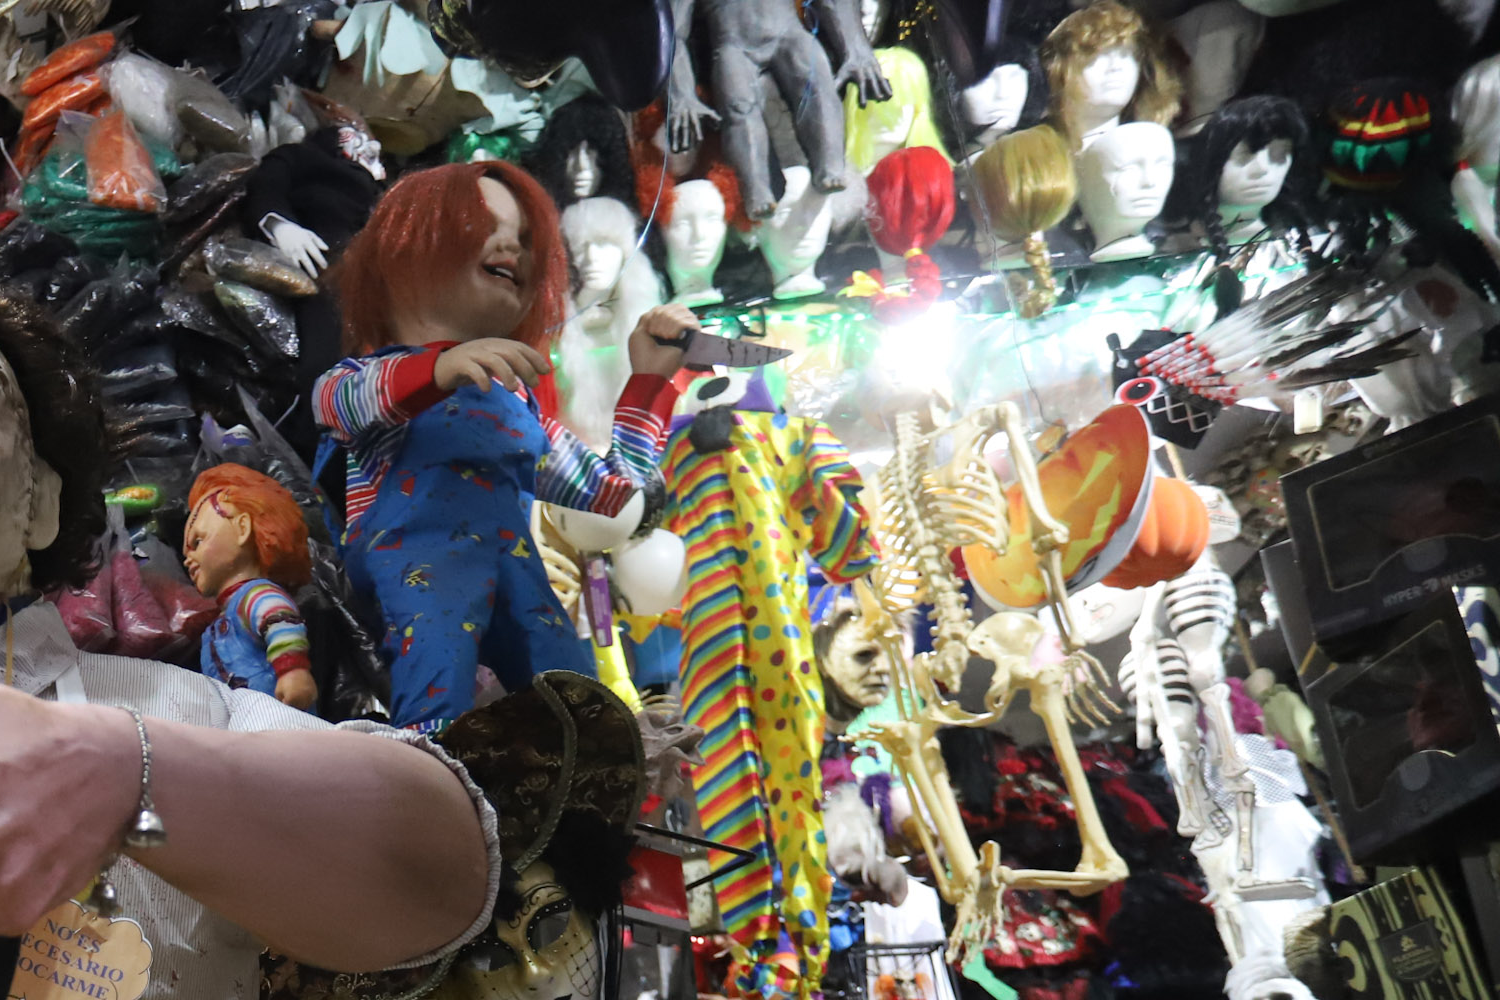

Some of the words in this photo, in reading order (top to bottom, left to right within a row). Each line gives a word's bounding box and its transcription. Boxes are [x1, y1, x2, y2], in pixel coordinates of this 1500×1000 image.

[1382, 585, 1422, 608] HYPER
[43, 918, 73, 941] NO
[77, 934, 101, 953] ES
[21, 932, 124, 982] ECESARIO
[17, 957, 110, 1000] OCARME
